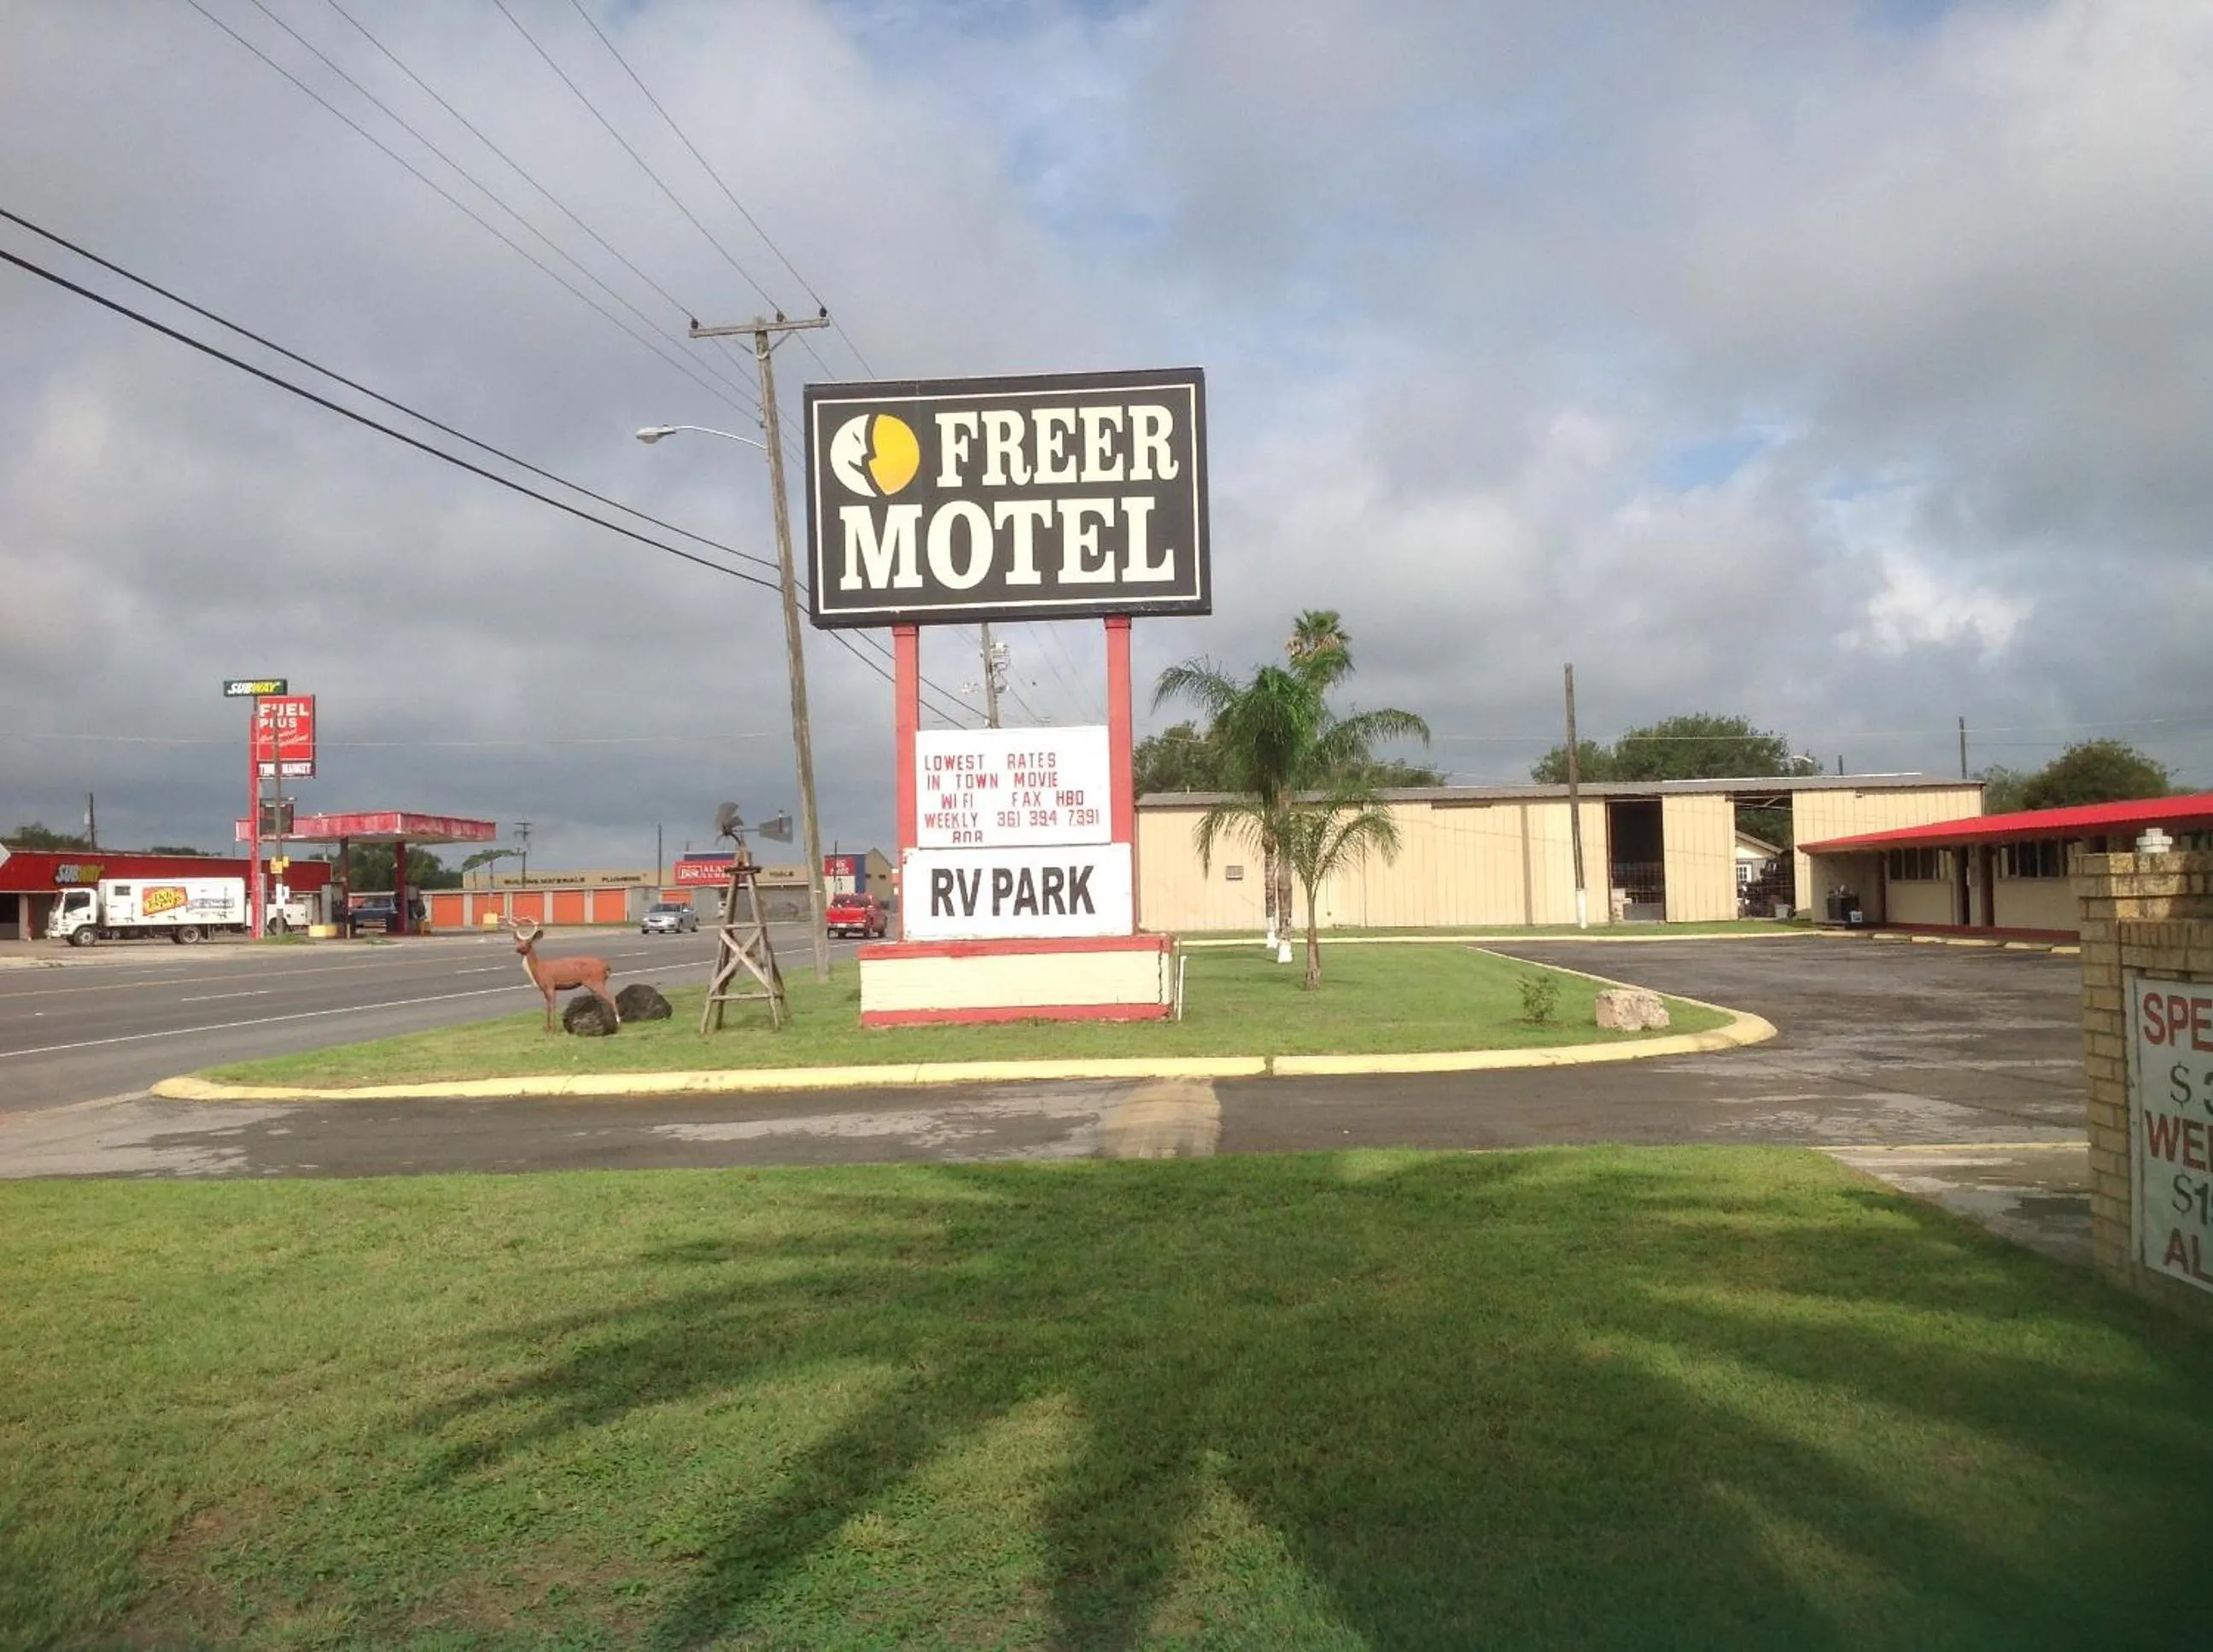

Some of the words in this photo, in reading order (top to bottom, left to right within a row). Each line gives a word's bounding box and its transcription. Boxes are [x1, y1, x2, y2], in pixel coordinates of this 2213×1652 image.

[935, 404, 1179, 487] FREER
[839, 496, 1175, 591] MOTEL
[227, 681, 280, 694] SUBWAY
[260, 703, 309, 717] FUEL
[925, 754, 984, 771] LOWEST
[1007, 752, 1055, 769] RATES
[928, 773, 940, 791] IN
[955, 773, 998, 791] TOWN
[1014, 772, 1058, 788] MOVIE
[1012, 791, 1042, 807] FAX
[1056, 790, 1083, 807] HBO
[925, 812, 978, 829] WEEKLY
[997, 810, 1019, 827] 361
[1030, 809, 1058, 826] 394
[1068, 808, 1099, 826] 7391
[55, 863, 104, 883] SUBWAY
[931, 868, 982, 917] RV
[992, 865, 1095, 917] PARK
